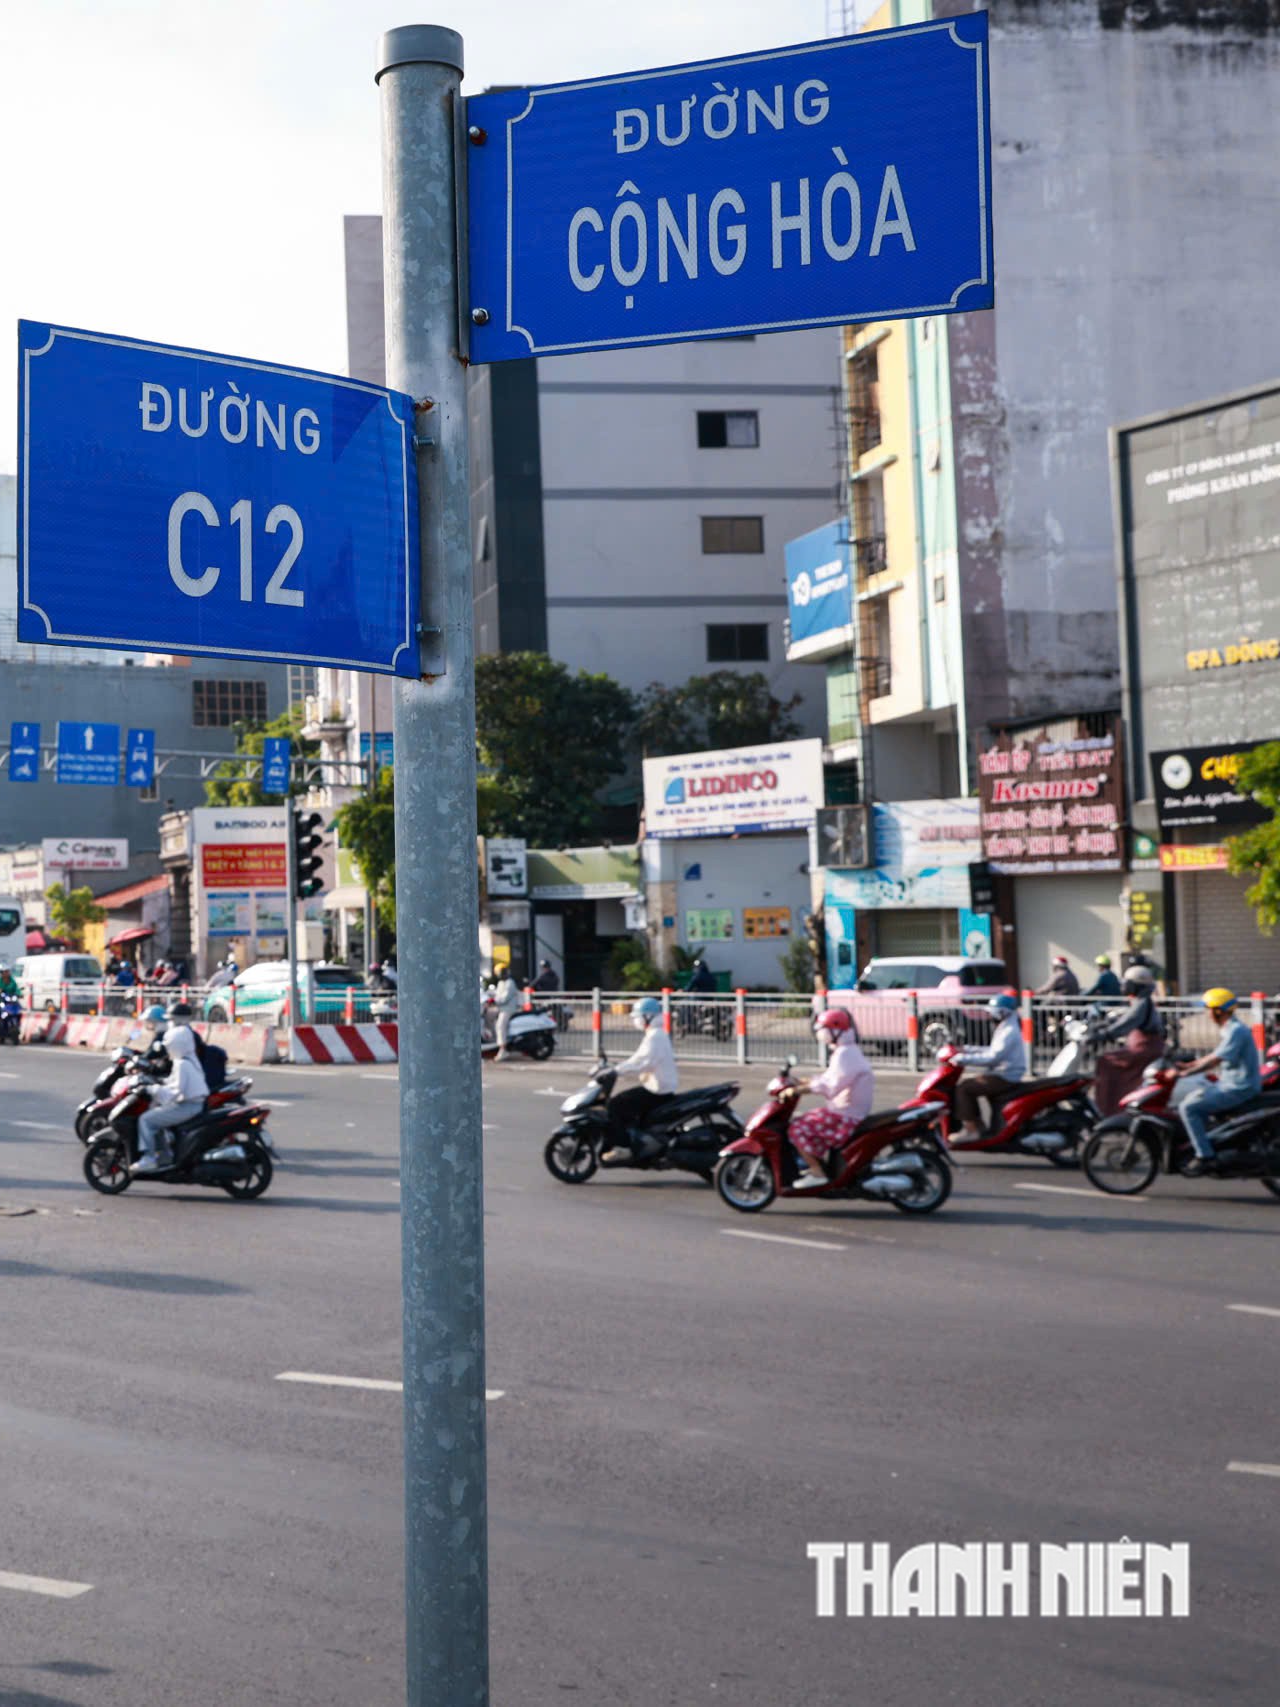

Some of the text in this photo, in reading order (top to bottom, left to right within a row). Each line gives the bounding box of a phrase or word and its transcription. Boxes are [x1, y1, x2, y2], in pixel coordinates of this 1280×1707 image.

[613, 79, 830, 154] ĐƯỜNG
[568, 146, 917, 310] CỘNG HÒA
[138, 381, 320, 455] ĐƯỜNG
[168, 491, 304, 608] C12
[688, 770, 779, 798] LIDINCO
[992, 777, 1100, 804] Kosmos
[215, 820, 286, 830] BAMBOO AI
